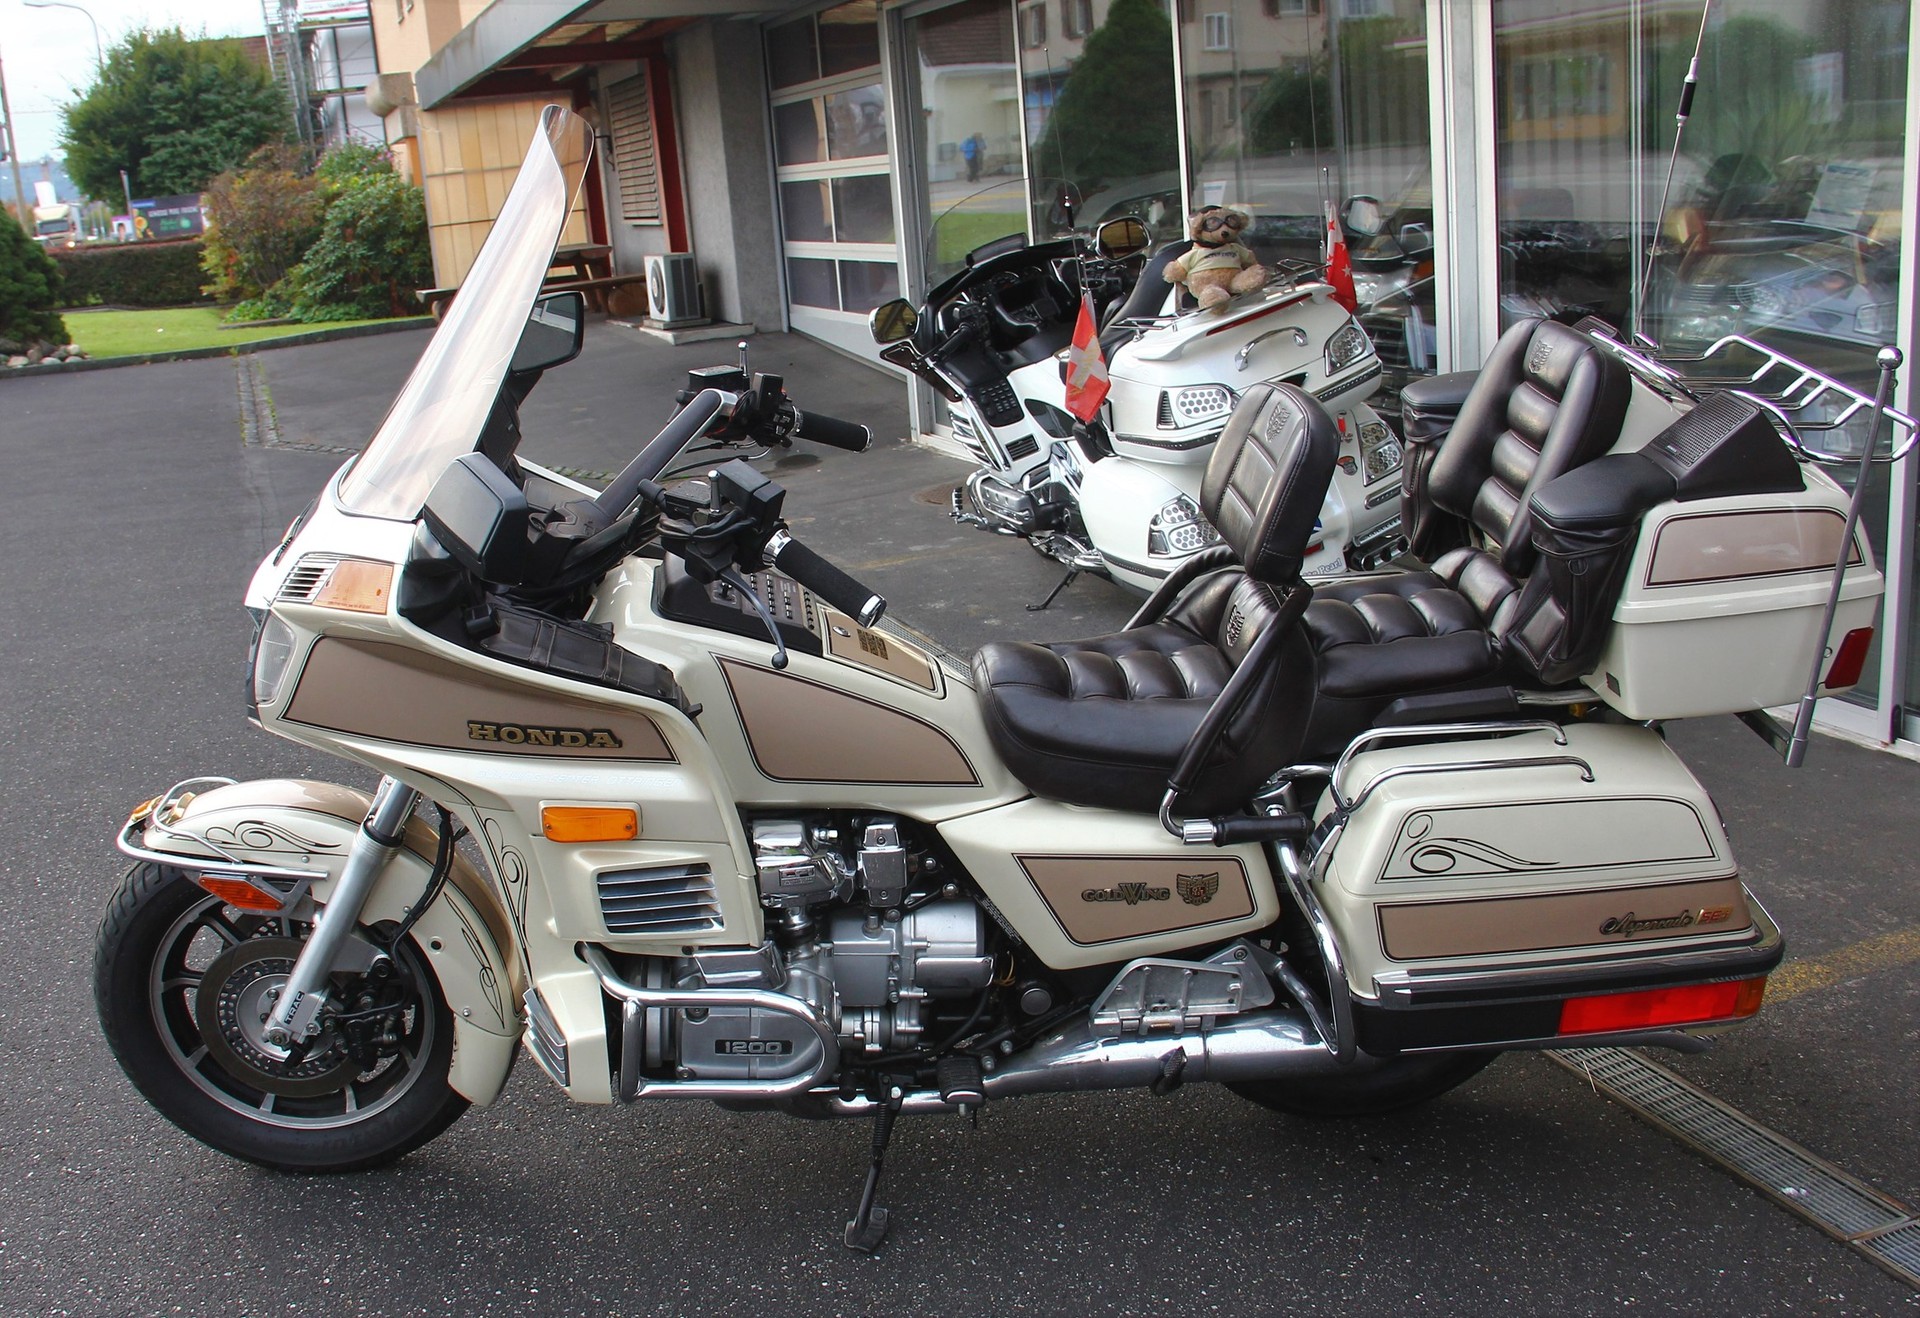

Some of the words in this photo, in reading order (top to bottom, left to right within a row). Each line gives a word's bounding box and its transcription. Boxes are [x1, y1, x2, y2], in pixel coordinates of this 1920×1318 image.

[1318, 557, 1343, 575] Pearl
[468, 721, 621, 749] HONDA
[285, 991, 305, 1024] TRAC
[725, 1041, 782, 1054] 1200
